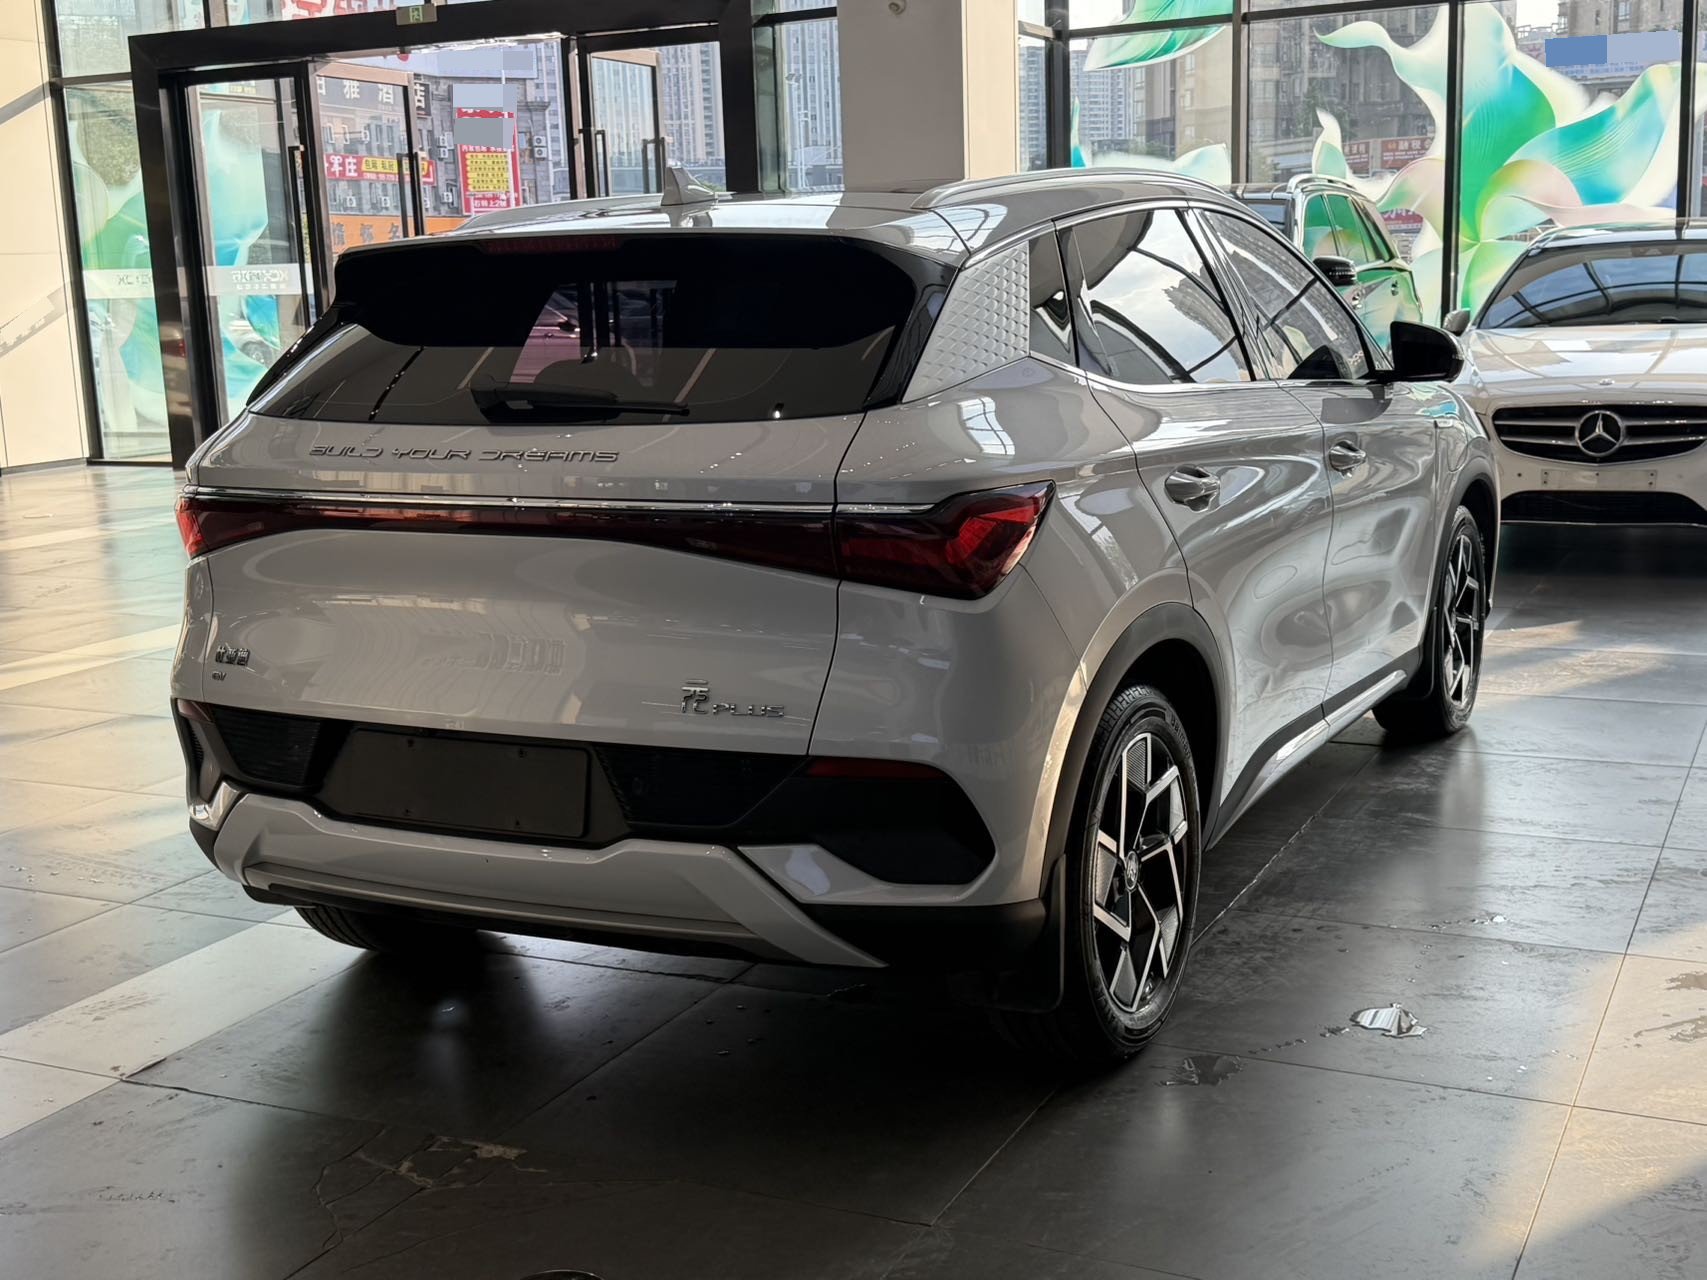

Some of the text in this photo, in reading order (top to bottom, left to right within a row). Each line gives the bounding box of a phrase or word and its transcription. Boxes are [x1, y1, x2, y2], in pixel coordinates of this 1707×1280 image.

[325, 155, 358, 178] 羊庄
[308, 444, 619, 463] BUILD YOUR DREAMS
[712, 702, 785, 718] PLUS
